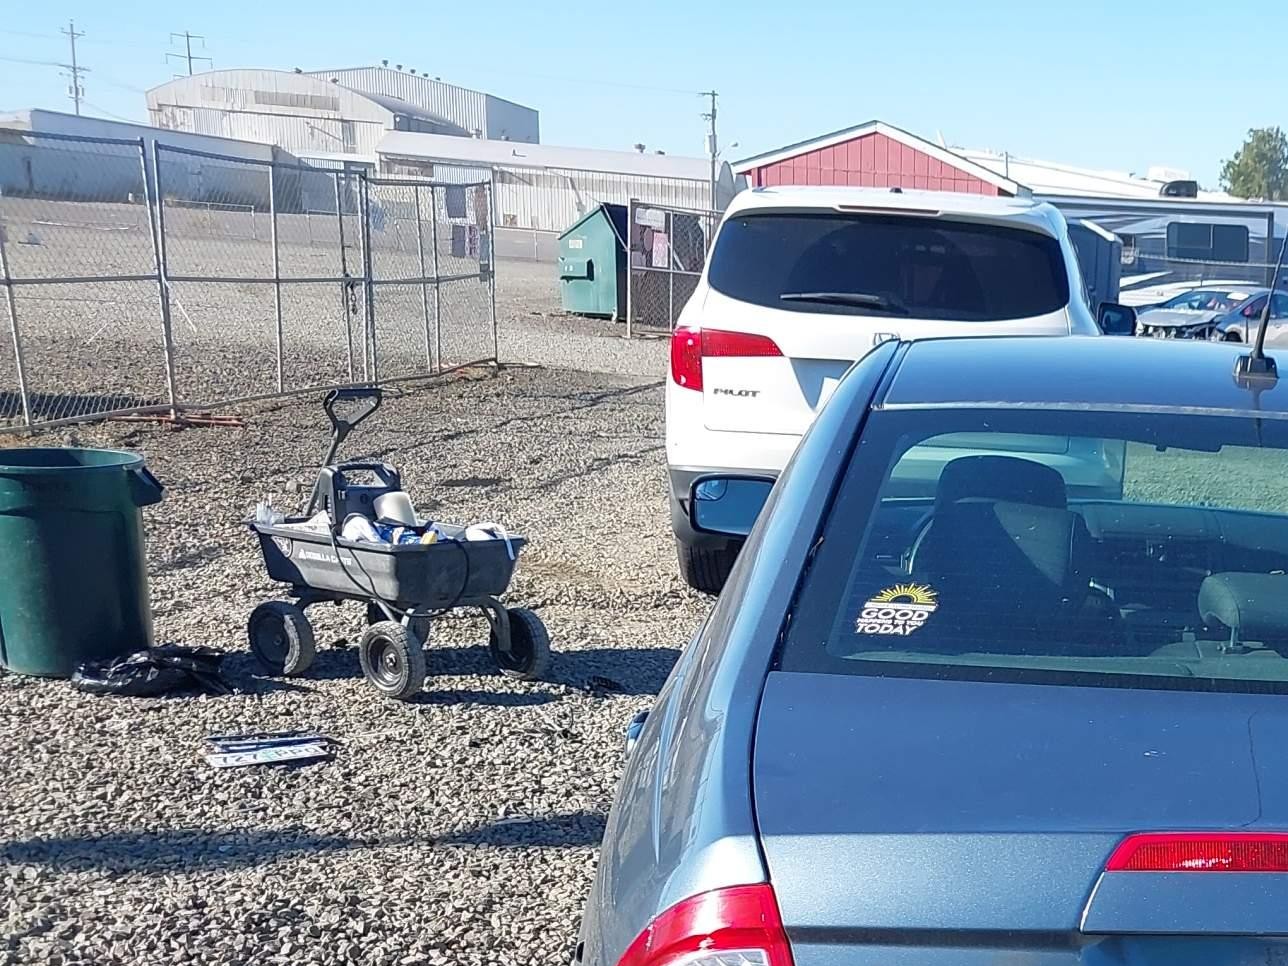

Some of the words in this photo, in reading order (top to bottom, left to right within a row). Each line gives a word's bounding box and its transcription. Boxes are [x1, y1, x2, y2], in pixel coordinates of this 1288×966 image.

[713, 388, 761, 398] PILOT
[861, 608, 929, 621] GOOD
[856, 623, 918, 635] TODAY
